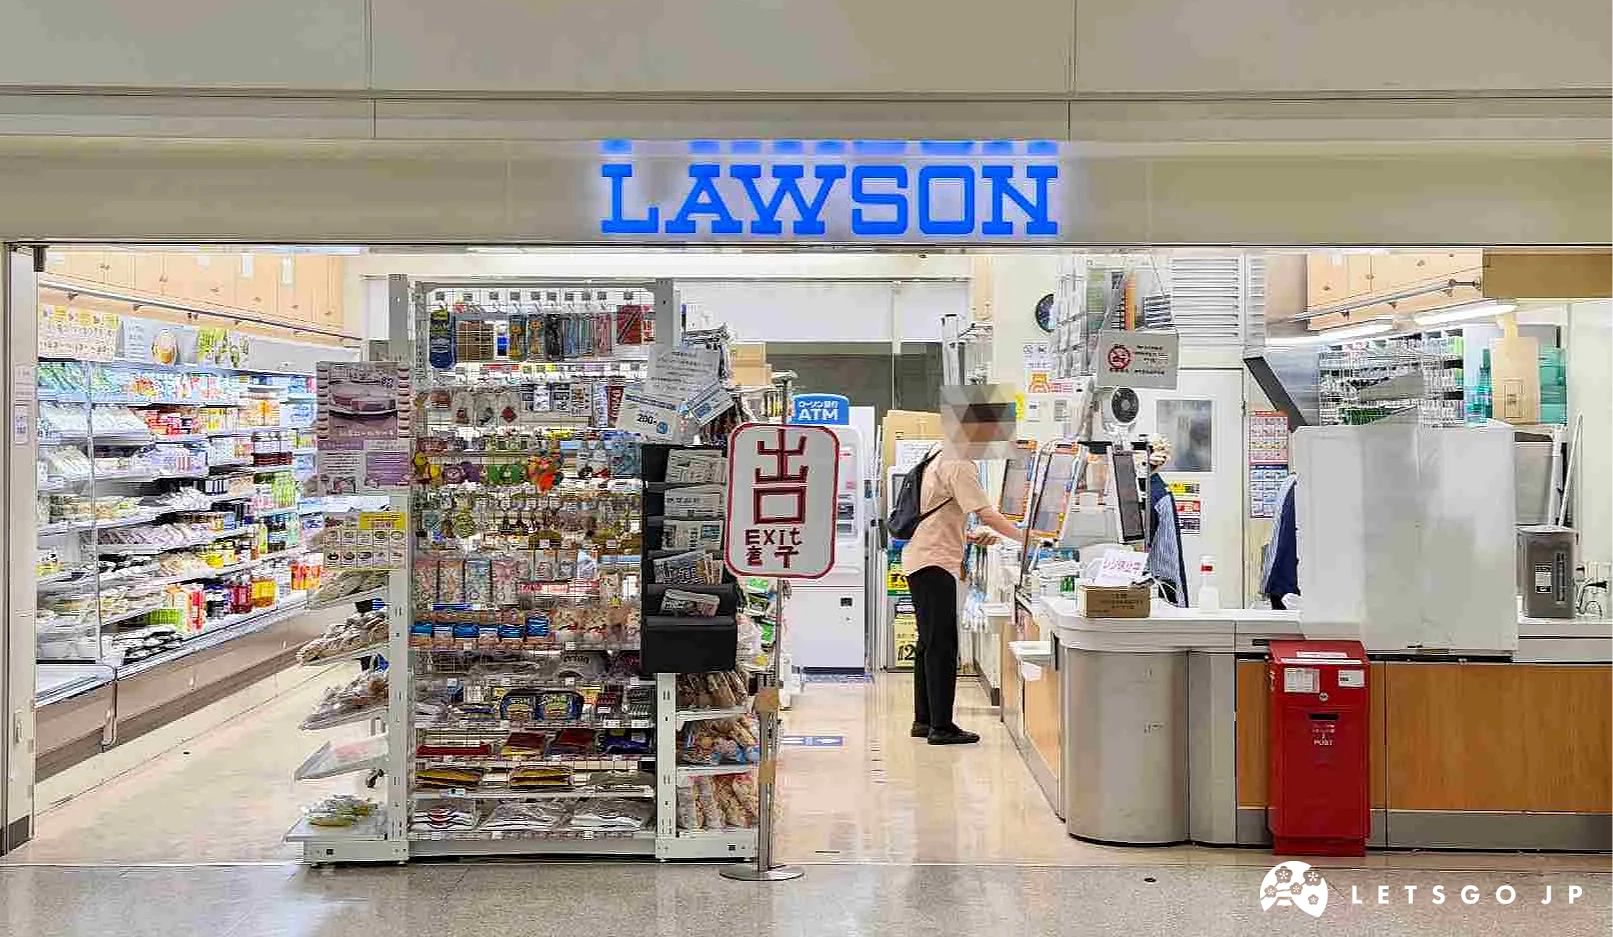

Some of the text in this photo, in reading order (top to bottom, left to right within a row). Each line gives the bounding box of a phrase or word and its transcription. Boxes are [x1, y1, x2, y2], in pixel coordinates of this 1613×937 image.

[601, 164, 1059, 235] LAWSON
[798, 409, 839, 421] ATM
[753, 428, 808, 524] 出口
